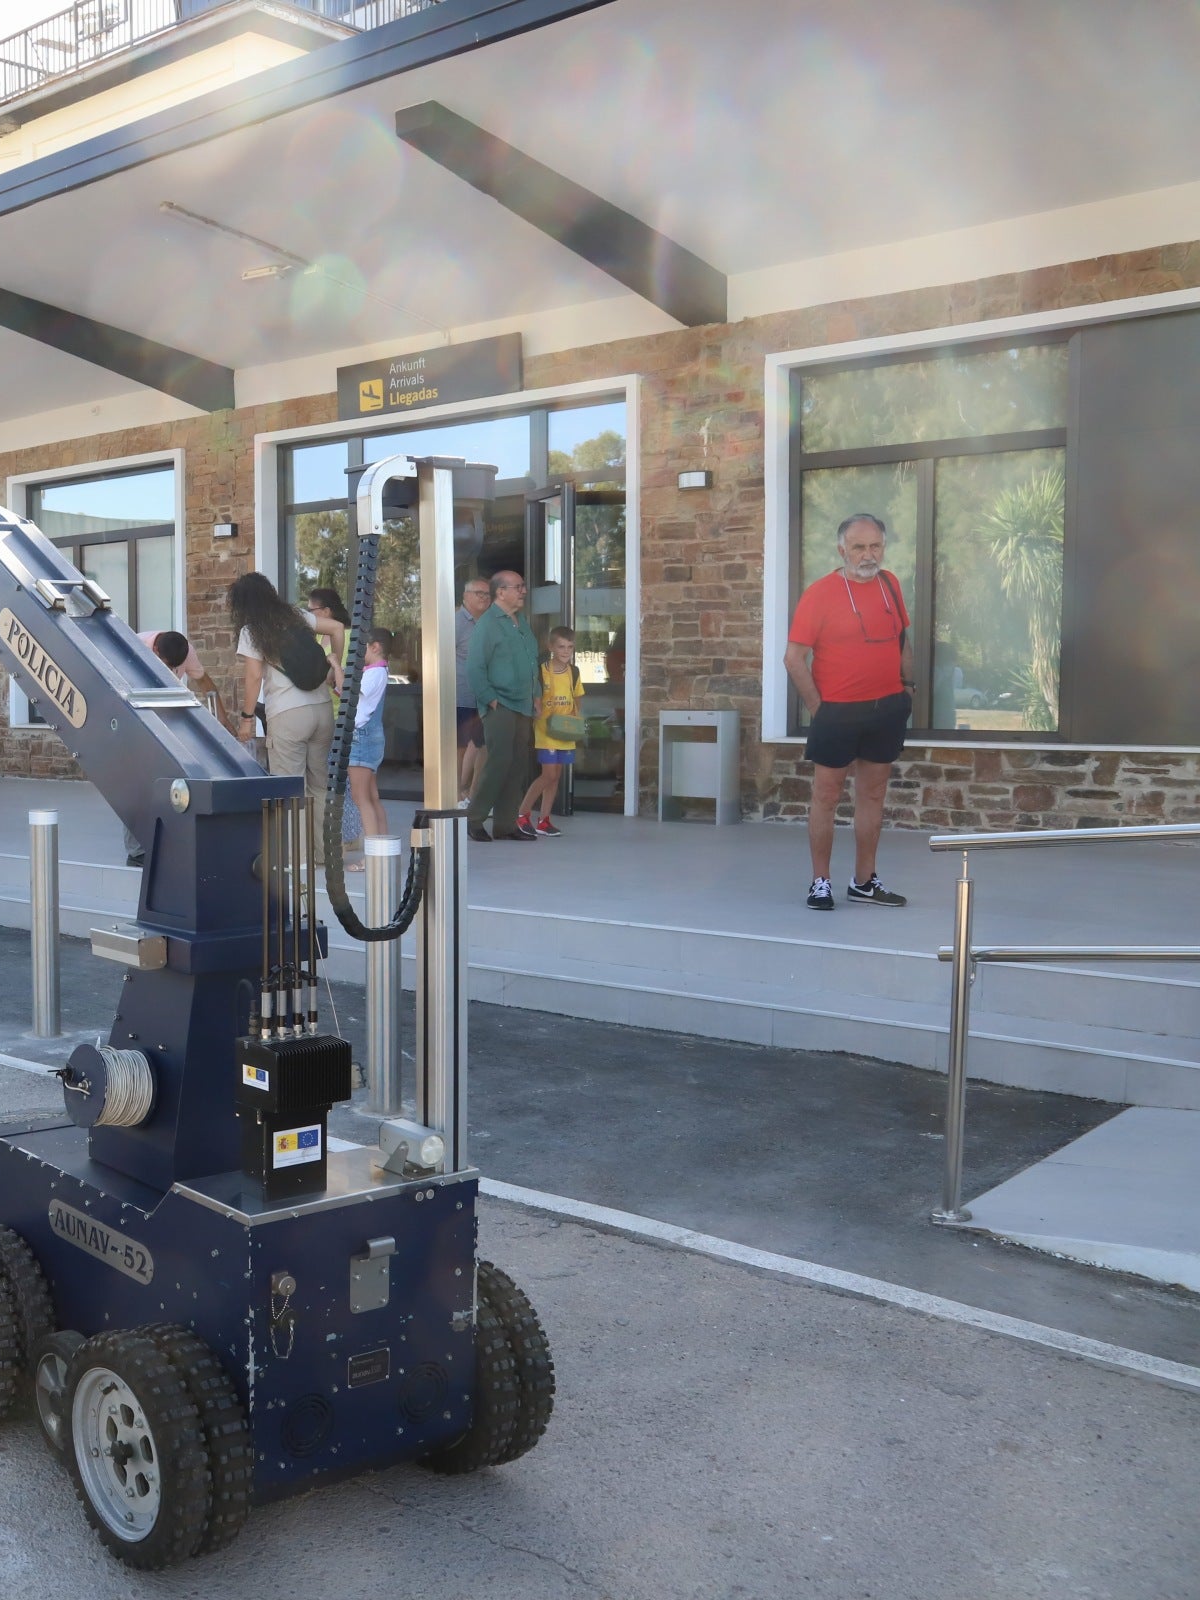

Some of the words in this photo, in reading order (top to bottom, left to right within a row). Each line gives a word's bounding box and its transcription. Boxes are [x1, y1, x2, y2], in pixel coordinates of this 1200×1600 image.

[389, 357, 426, 374] Ankunft
[389, 372, 425, 389] Arrivals
[390, 387, 438, 406] Llegadas
[6, 618, 76, 719] POLICIA
